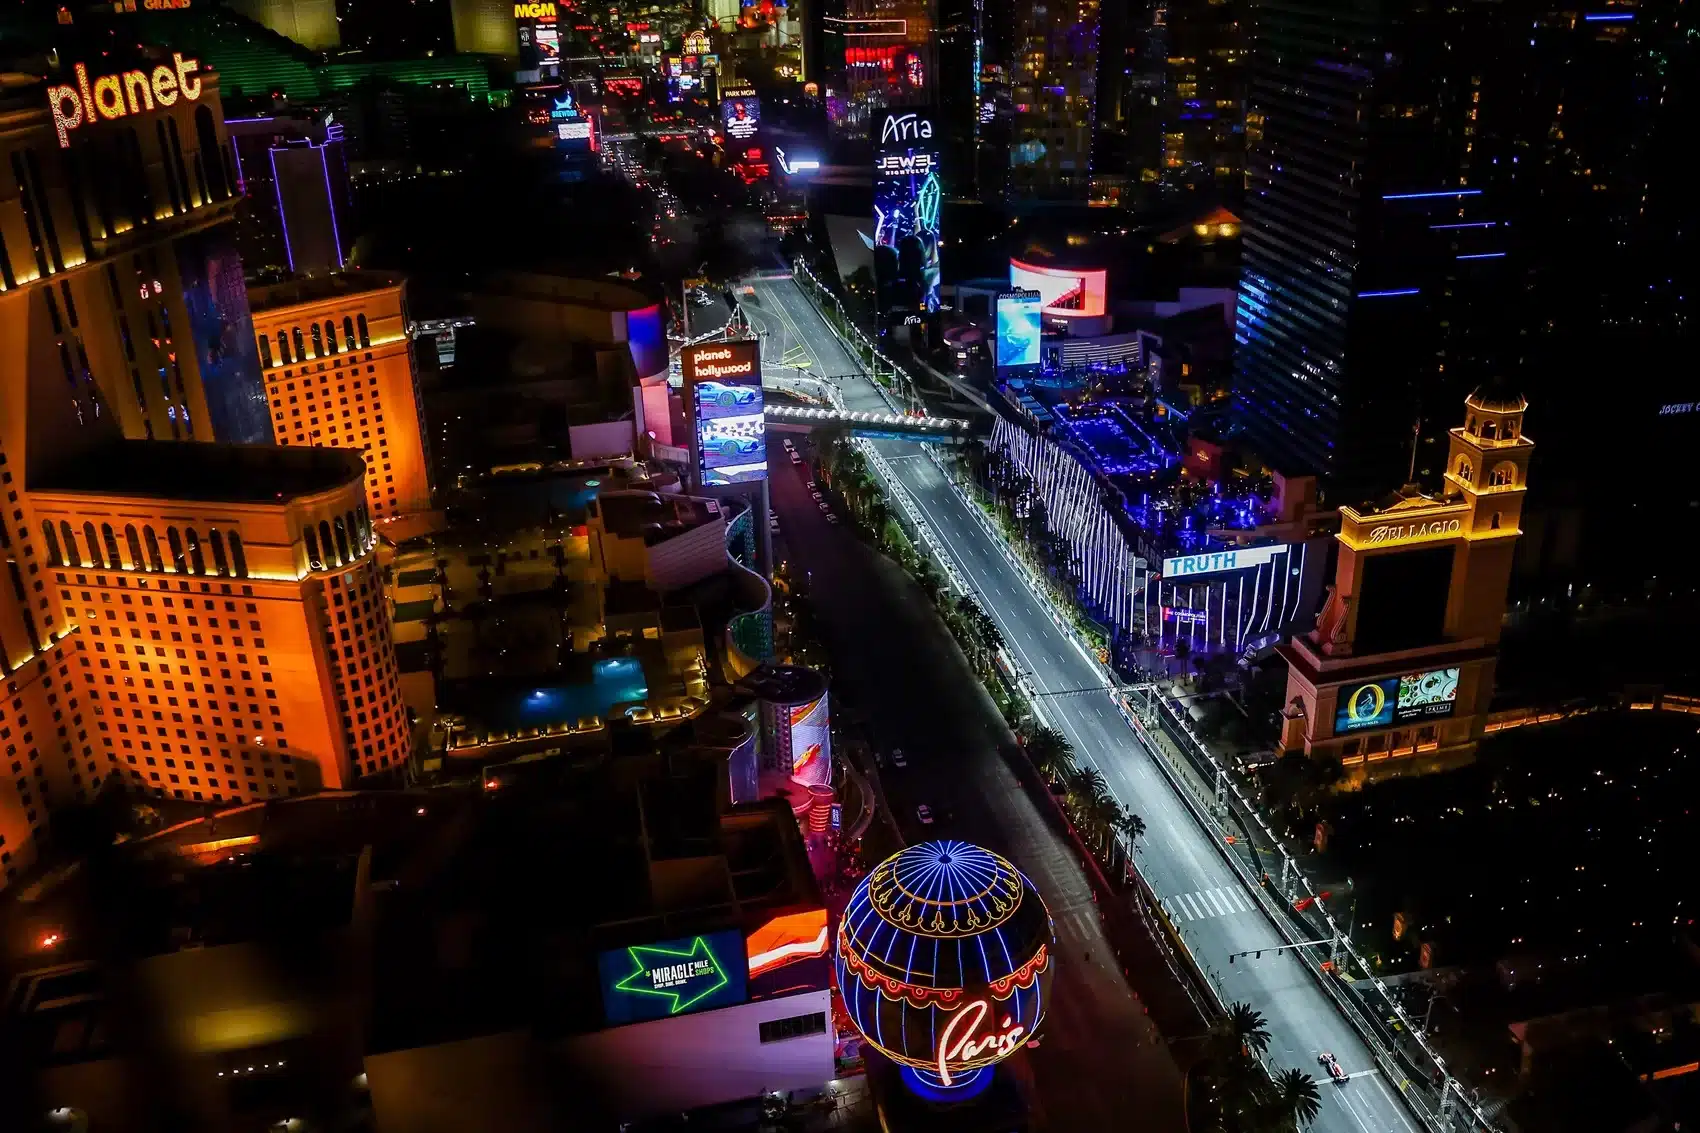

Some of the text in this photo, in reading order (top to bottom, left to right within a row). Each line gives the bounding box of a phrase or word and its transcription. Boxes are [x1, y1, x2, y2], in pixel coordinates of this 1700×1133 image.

[515, 3, 556, 18] MGM
[47, 52, 202, 148] planet
[881, 113, 932, 144] Aria
[877, 154, 936, 169] JEWEL
[903, 315, 921, 325] Aria
[694, 349, 731, 364] planet
[695, 362, 751, 377] hollywood
[1364, 519, 1460, 544] BELLAGIO
[1170, 552, 1236, 574] TRUTH
[1428, 705, 1448, 713] PRIME
[652, 960, 708, 983] MIRACLE MILE
[695, 967, 714, 976] SHOPS
[939, 1000, 1024, 1086] Paris
